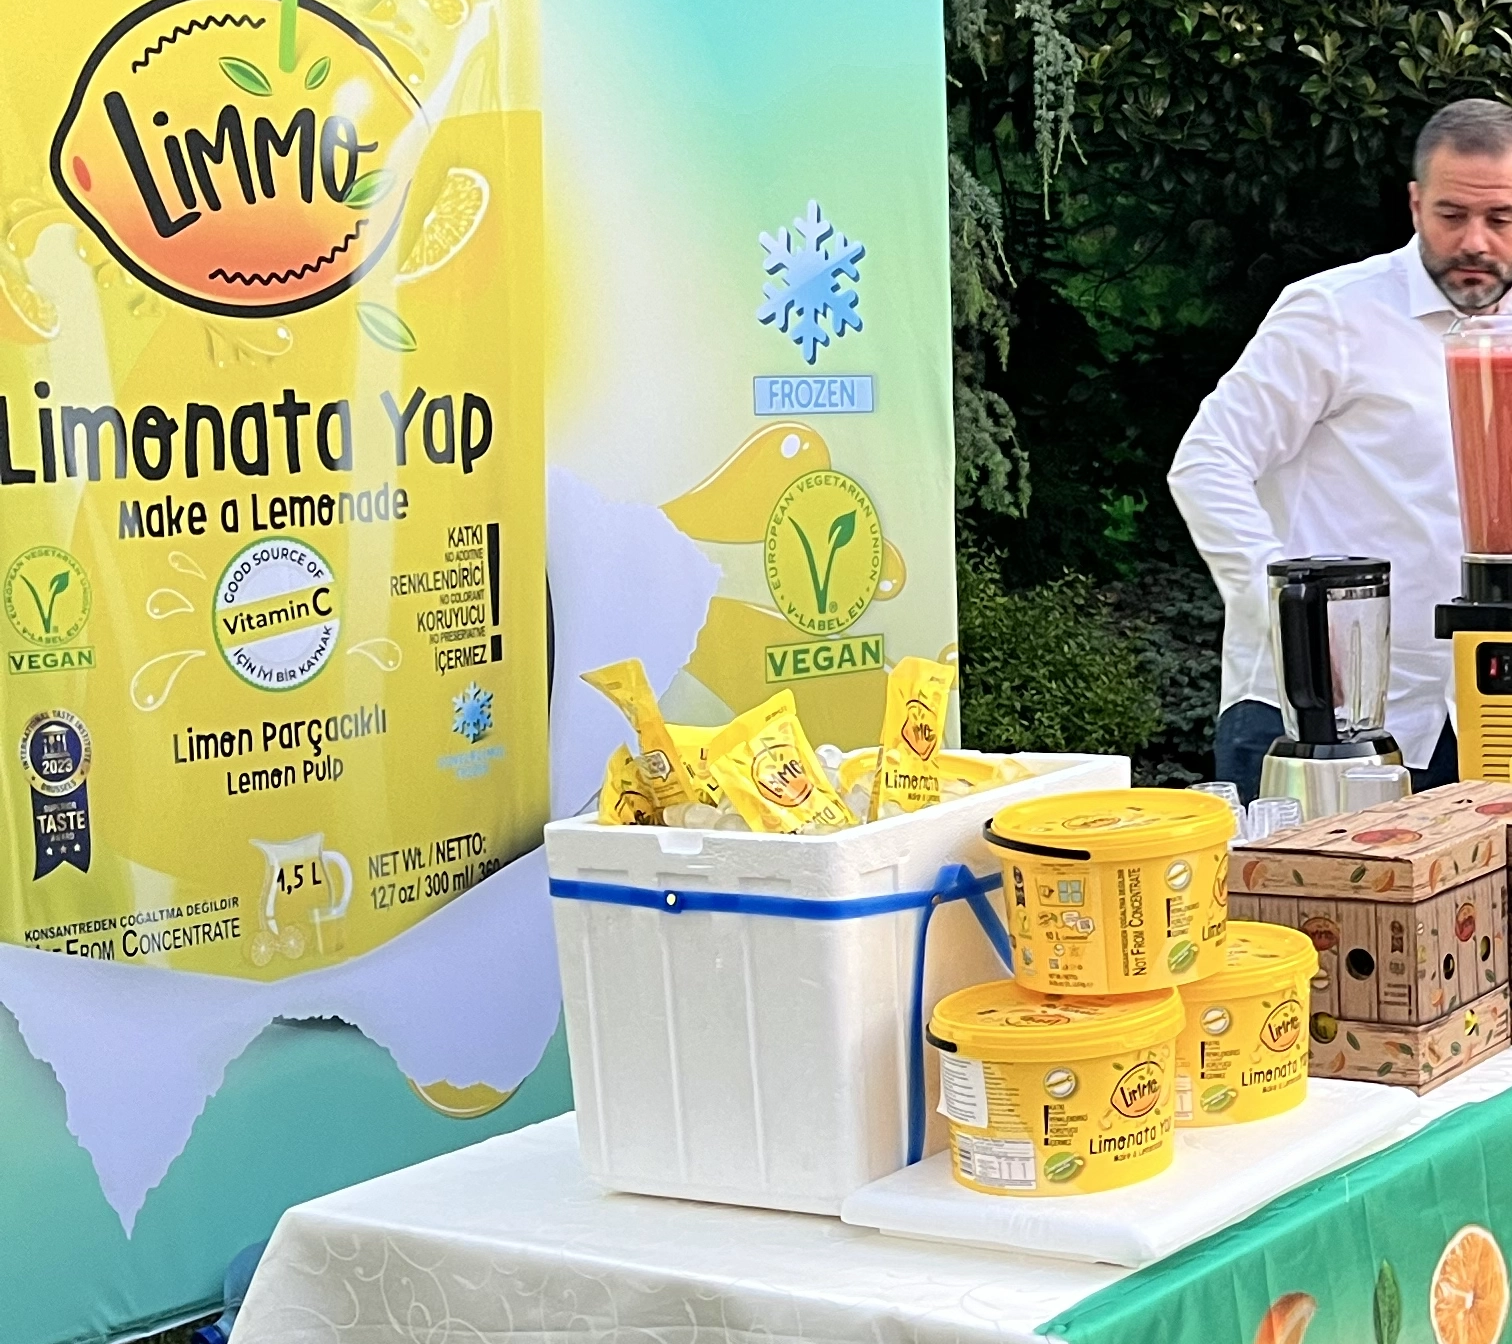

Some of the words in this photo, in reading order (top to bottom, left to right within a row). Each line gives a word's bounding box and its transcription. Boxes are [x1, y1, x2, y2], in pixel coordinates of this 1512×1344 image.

[769, 379, 855, 409] FROZEN
[0, 380, 353, 486] Limonata
[380, 386, 494, 475] Yap
[118, 494, 208, 540] Make
[220, 499, 240, 534] a
[251, 482, 409, 532] Lemonade
[447, 524, 484, 549] KATKI
[768, 492, 795, 590] EUROPEAN
[796, 474, 872, 518] VEGETARIAN
[868, 522, 881, 582] UNION
[224, 561, 252, 604] GOOD
[252, 547, 307, 567] SOURCE
[306, 561, 325, 579] OF
[390, 560, 485, 597] RENKLENDİRİCİ
[223, 600, 310, 635] Vitamin
[312, 587, 333, 617] C
[416, 604, 486, 633] KORUYUCU
[9, 650, 94, 671] VEGAN
[298, 625, 333, 676] KAYNAK
[435, 643, 488, 677] İÇERMEZ
[767, 639, 881, 677] VEGAN
[172, 726, 254, 765] Limon
[262, 702, 388, 757] Parçacıklı
[42, 757, 74, 775] 2023
[227, 765, 296, 796] Lemon
[303, 754, 344, 784] Pulp
[36, 810, 87, 835] TASTE
[368, 850, 400, 881] NET
[436, 832, 487, 865] NETTO:
[276, 864, 304, 895] 1,5
[311, 861, 322, 886] L
[424, 870, 449, 898] 300
[24, 917, 117, 942] KONSANTREDEN
[1241, 1059, 1298, 1087] Limonata
[1089, 1125, 1157, 1155] Limonata
[1160, 1115, 1172, 1136] Ya
